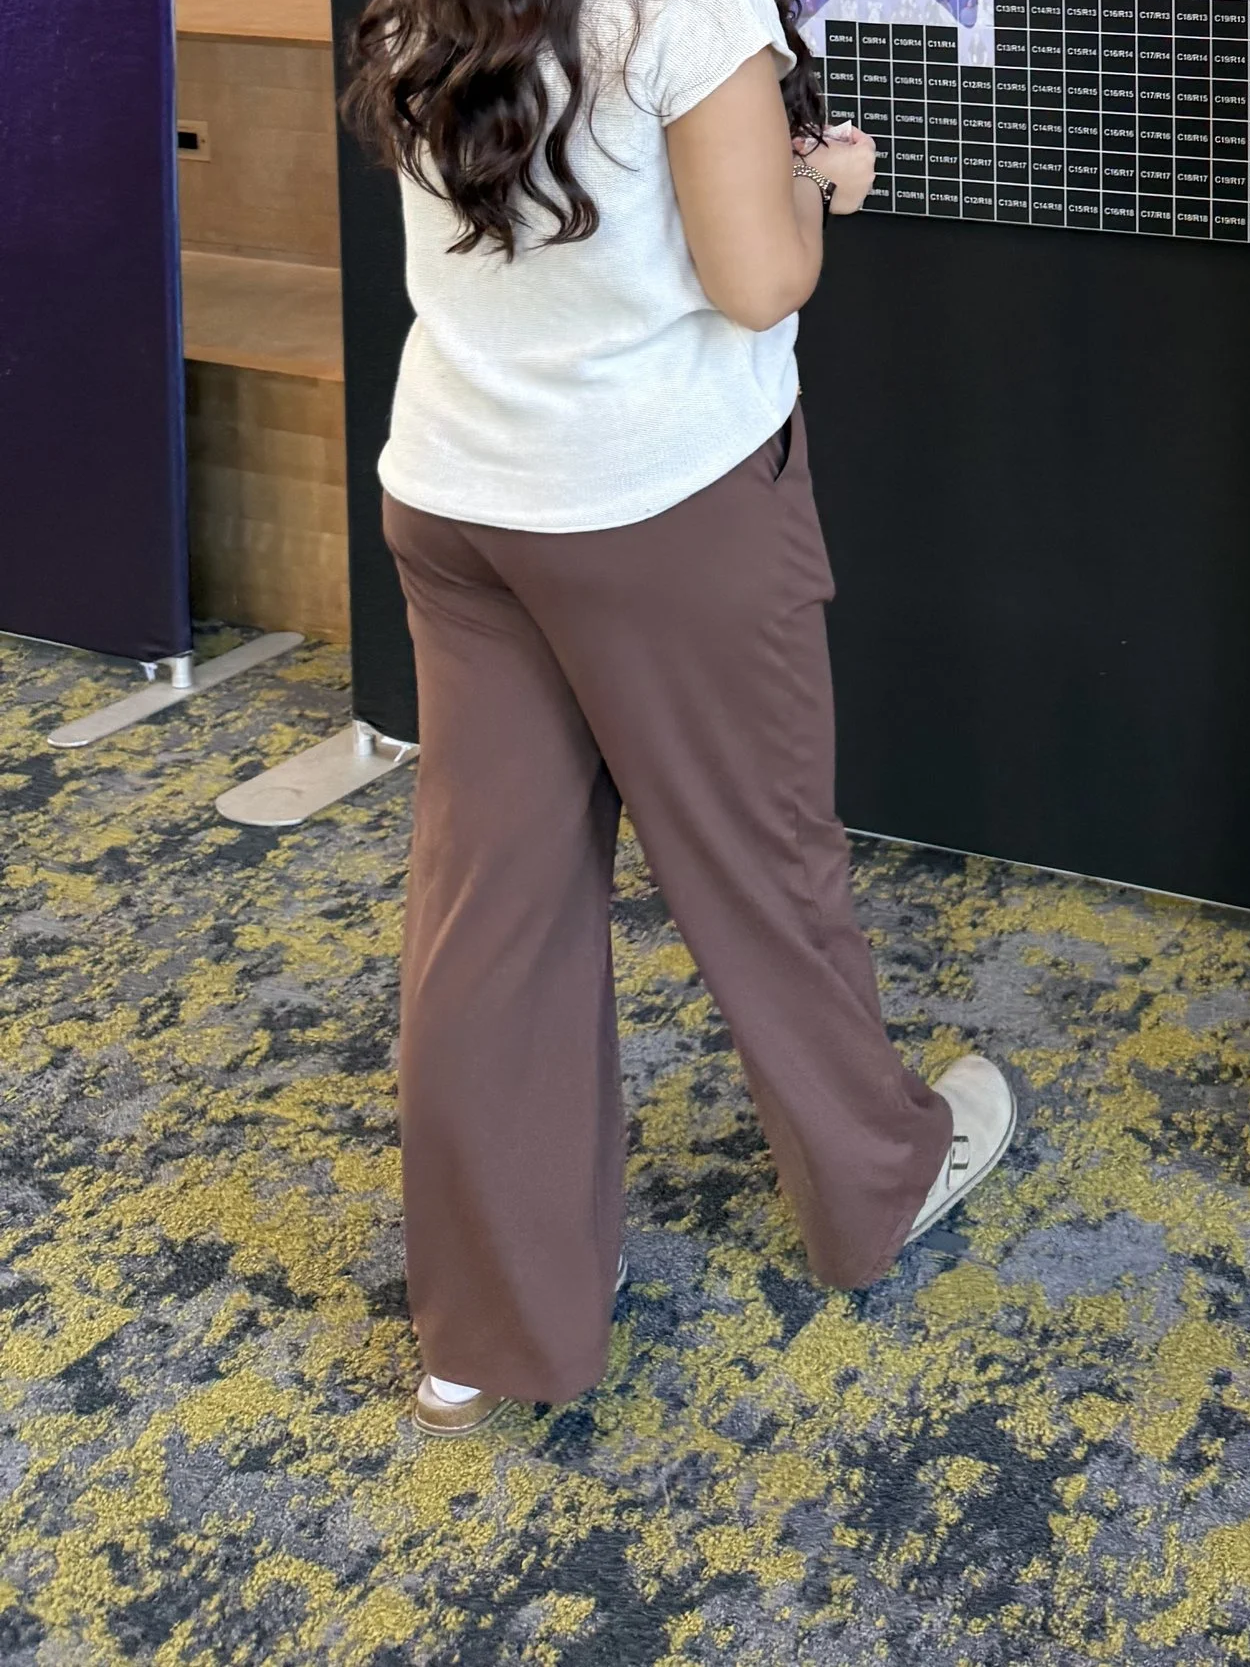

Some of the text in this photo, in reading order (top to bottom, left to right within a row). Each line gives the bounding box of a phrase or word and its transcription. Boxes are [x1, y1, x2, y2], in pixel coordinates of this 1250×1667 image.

[995, 4, 1026, 14] C13/R13
[1030, 6, 1061, 15] C14/R13
[1066, 7, 1097, 17] C15/R13
[1102, 9, 1134, 19] C16/R13
[1139, 11, 1171, 20] C17/R13
[1176, 12, 1209, 22] C18/R13
[1213, 14, 1246, 24] C19/R13
[893, 38, 922, 47] C10/R14
[927, 39, 956, 49] C11/R14
[996, 43, 1026, 52] C13/R14
[1031, 45, 1062, 54] C14/R14
[1066, 47, 1097, 56] C15/R14
[1103, 49, 1134, 58] C16/R14
[1139, 51, 1171, 60] C17/R14
[1176, 52, 1208, 62] C18/R14
[1213, 54, 1246, 64] C19/R14
[894, 76, 923, 86] C10/R15
[927, 78, 957, 88] C11/R15
[962, 80, 992, 90] C12/R15
[996, 82, 1027, 92] C13/R15
[1031, 84, 1062, 94] C14/R15
[1067, 86, 1098, 96] C15/R15
[1103, 88, 1135, 98] C16/R15
[1139, 90, 1171, 101] C17/R15
[1176, 93, 1209, 103] C18/R15
[1214, 95, 1246, 105] C19/R15
[895, 114, 924, 124] C10/R16
[928, 116, 958, 126] C11/R16
[962, 119, 992, 129] C12/R16
[997, 121, 1027, 131] C13/R16
[1032, 123, 1063, 133] C14/R16
[1067, 126, 1099, 136] C15/R16
[1103, 128, 1135, 138] C16/R16
[1139, 130, 1172, 141] C17/R16
[1176, 133, 1209, 143] C18/R16
[1214, 135, 1247, 145] C19/R16
[895, 152, 925, 162] C10/R17
[929, 154, 958, 164] C11/R17
[963, 157, 993, 167] C12/R17
[997, 160, 1028, 169] C13/R17
[1032, 162, 1063, 172] C14/R17
[1068, 165, 1099, 175] C15/R17
[1103, 167, 1135, 177] C16/R17
[1140, 170, 1172, 180] C17/R17
[1176, 173, 1209, 183] C18/R17
[1214, 175, 1246, 186] C19/R17
[896, 190, 925, 200] C10/R18
[929, 193, 959, 203] C11/R18
[963, 195, 993, 206] C12/R18
[998, 198, 1028, 208] C13/R18
[1032, 201, 1063, 211] C14/R18
[1068, 204, 1099, 214] C15/R18
[1103, 207, 1135, 217] C16/R18
[1140, 209, 1172, 220] C17/R18
[1176, 212, 1209, 223] C18/R18
[1214, 215, 1246, 226] C19/R18
